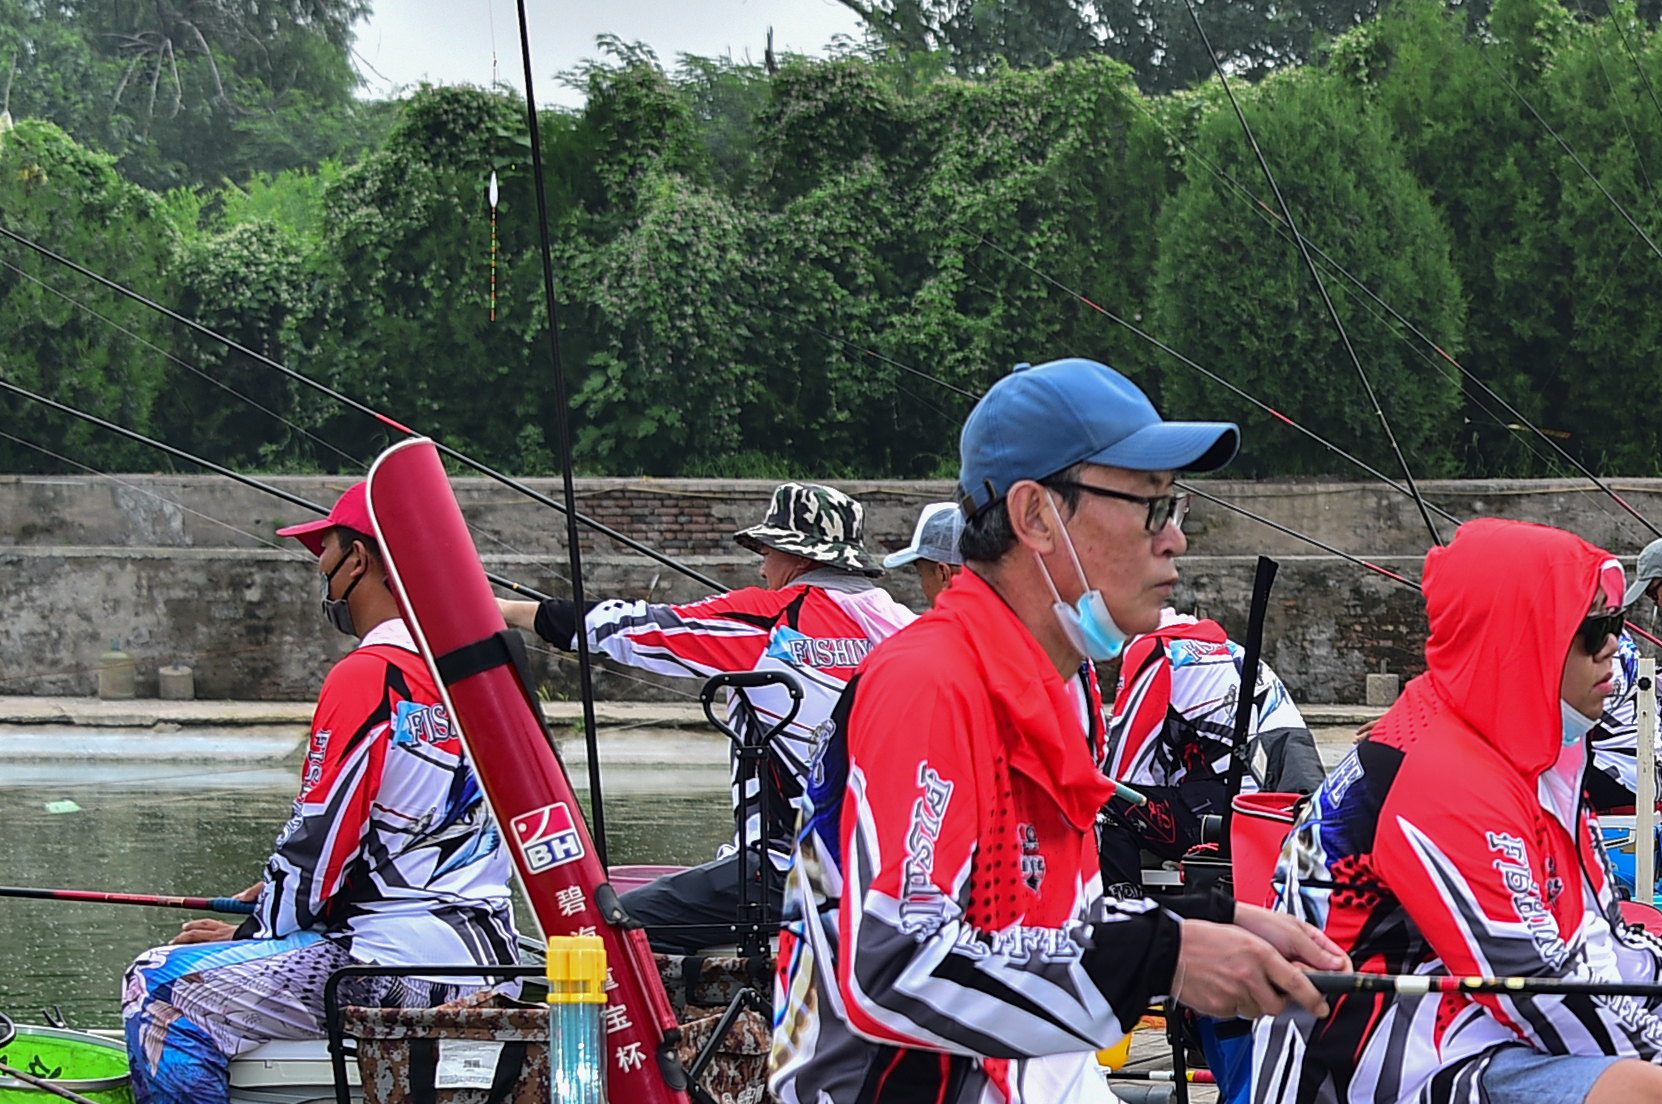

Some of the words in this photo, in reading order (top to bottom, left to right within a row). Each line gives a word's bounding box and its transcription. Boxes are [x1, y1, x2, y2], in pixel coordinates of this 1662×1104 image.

[786, 638, 874, 669] FISHIN
[406, 703, 458, 748] FIS
[532, 836, 582, 868] BH
